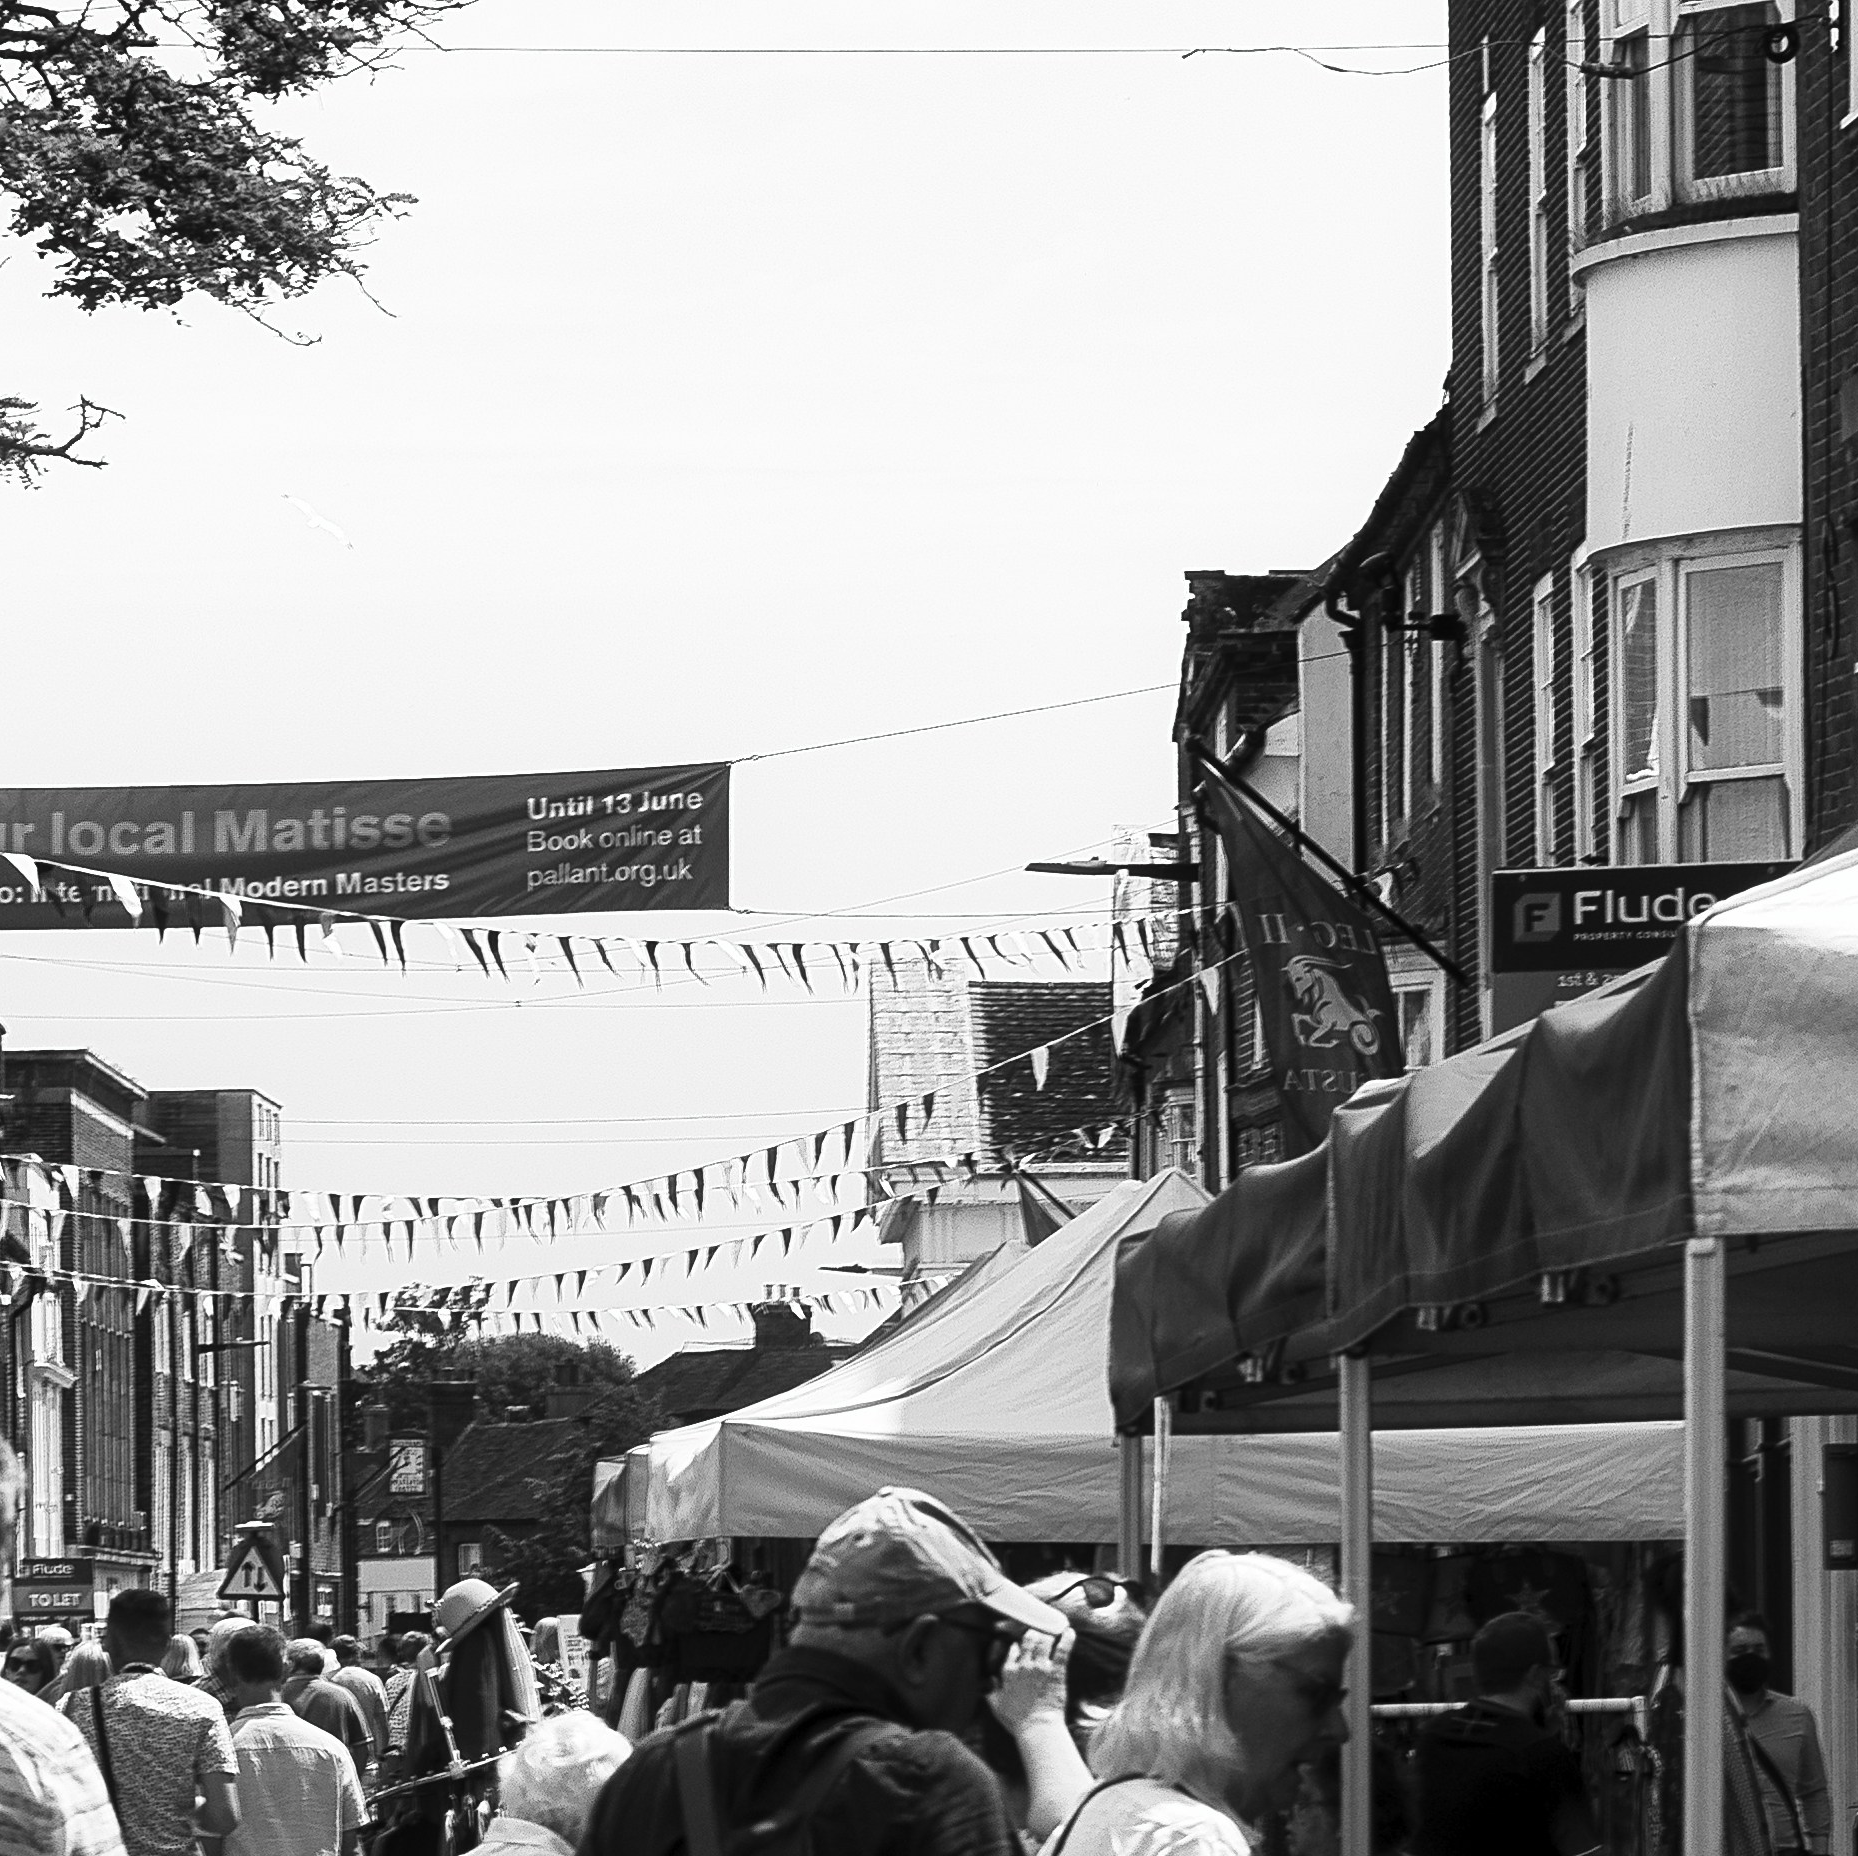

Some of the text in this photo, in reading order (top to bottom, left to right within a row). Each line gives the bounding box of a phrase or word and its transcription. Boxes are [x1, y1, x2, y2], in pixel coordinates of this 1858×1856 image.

[527, 790, 704, 820] Until 13 June
[50, 810, 196, 858] local
[214, 806, 451, 855] Matisse
[527, 824, 703, 853] Book online at
[217, 876, 326, 900] Modern
[335, 870, 450, 896] Masters
[527, 858, 693, 893] pallant.org.uk
[1574, 886, 1718, 925] Flude
[29, 1592, 82, 1607] TO LET
